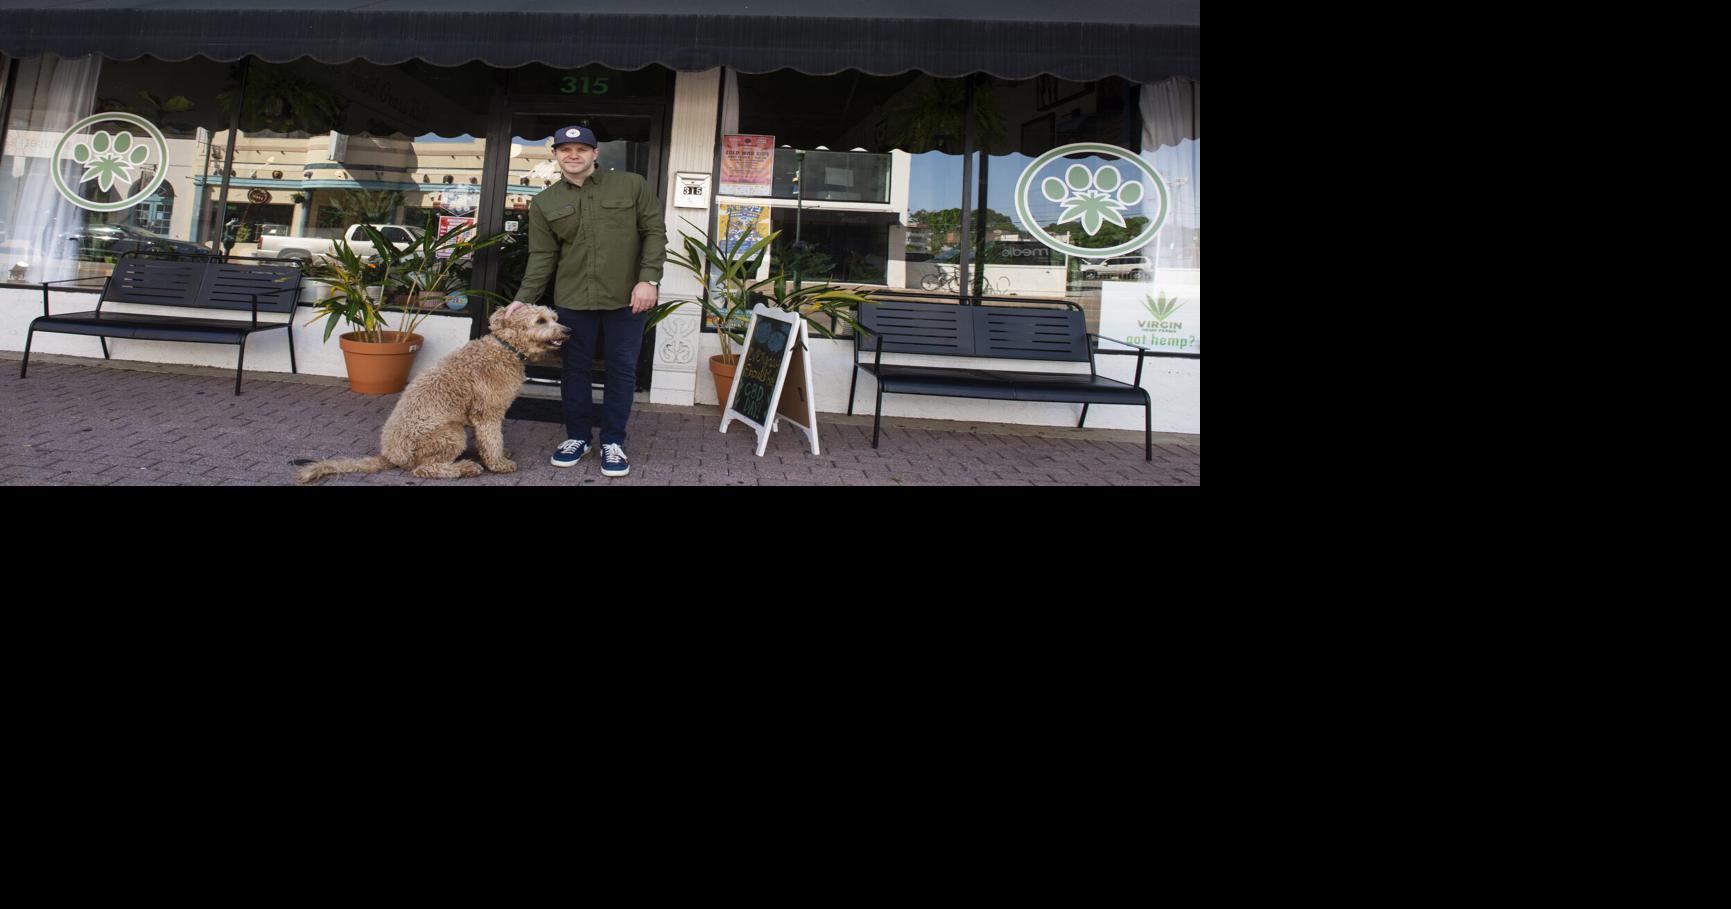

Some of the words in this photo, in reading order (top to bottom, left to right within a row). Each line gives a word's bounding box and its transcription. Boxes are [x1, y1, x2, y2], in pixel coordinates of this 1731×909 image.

[560, 76, 608, 94] 315
[683, 186, 703, 195] 315
[1137, 320, 1183, 330] VIRGIN
[1126, 335, 1146, 346] got
[1151, 334, 1195, 350] hemp?
[745, 383, 764, 401] CBD
